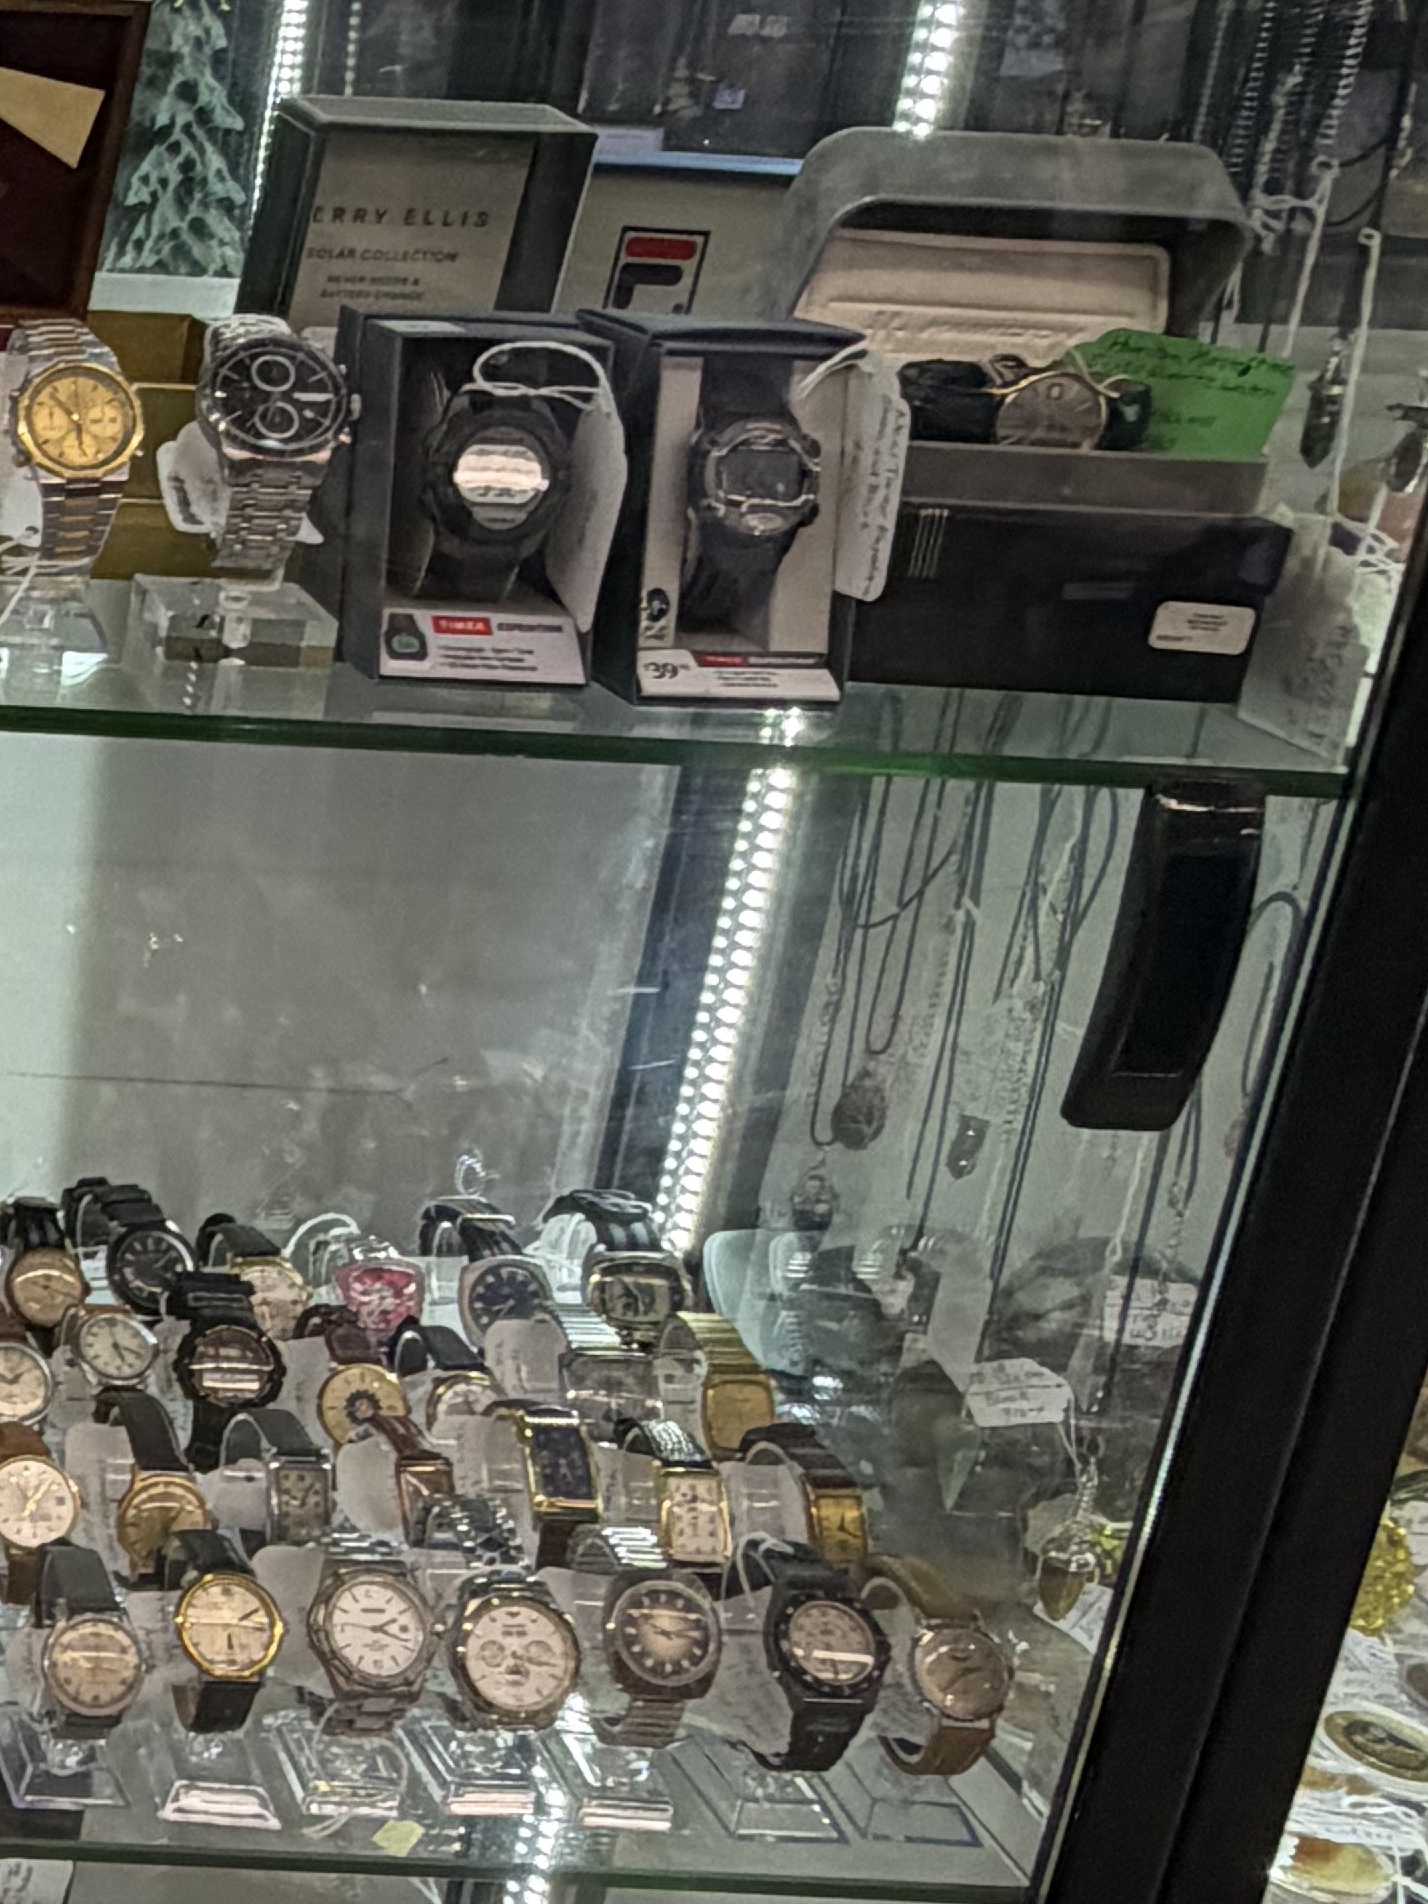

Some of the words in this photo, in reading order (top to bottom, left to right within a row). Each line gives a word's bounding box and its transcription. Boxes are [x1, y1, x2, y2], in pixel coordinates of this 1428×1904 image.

[312, 206, 389, 225] ERRY
[403, 208, 490, 228] ELLIS
[307, 247, 356, 261] SOLAR
[360, 248, 459, 263] COLLECTION
